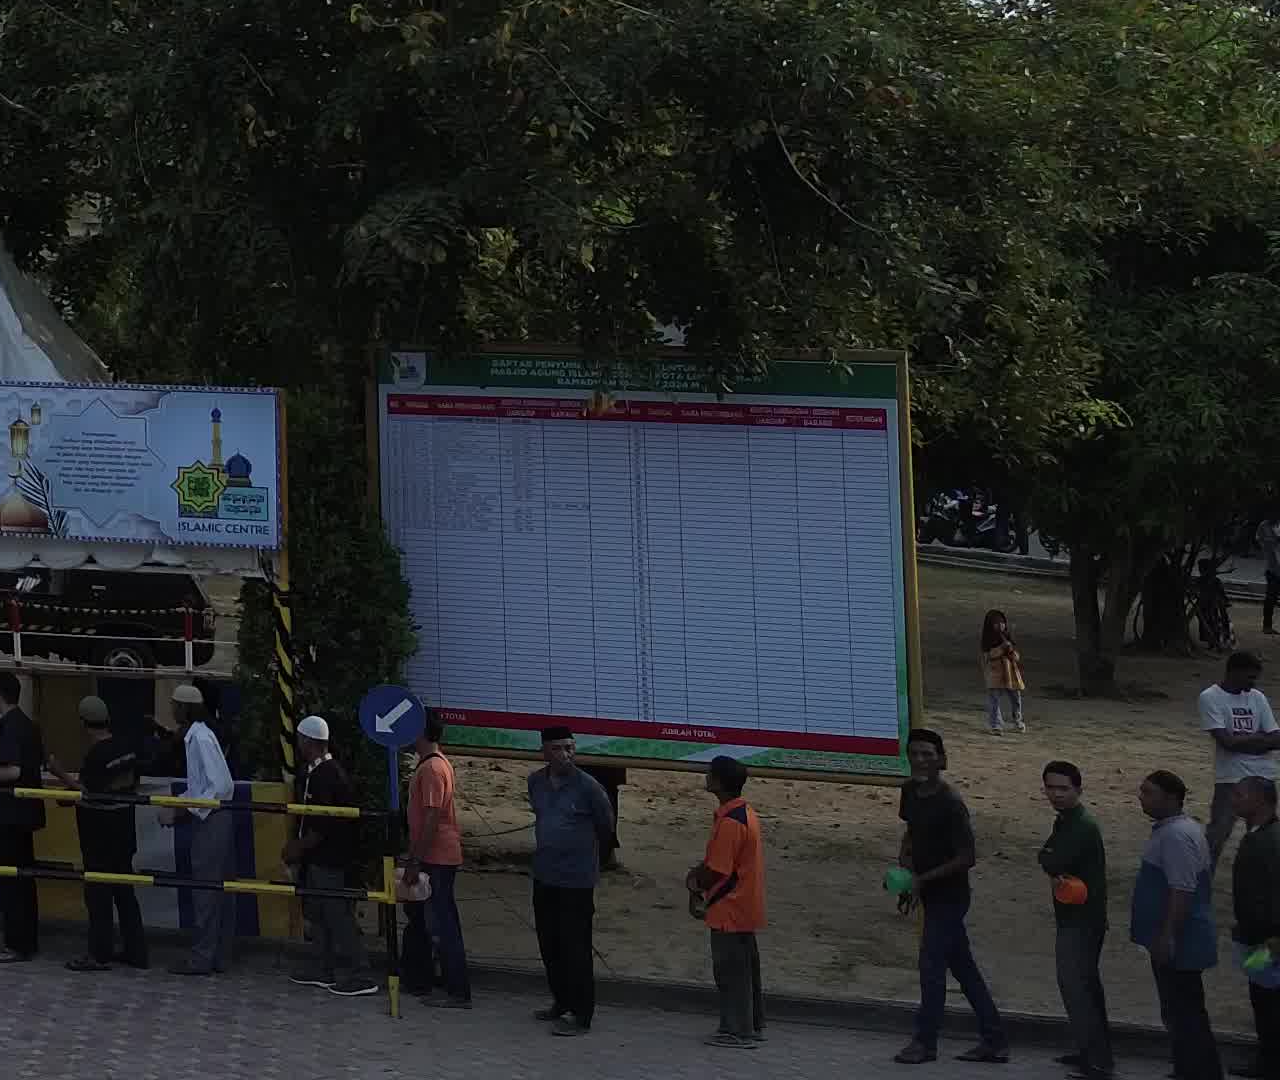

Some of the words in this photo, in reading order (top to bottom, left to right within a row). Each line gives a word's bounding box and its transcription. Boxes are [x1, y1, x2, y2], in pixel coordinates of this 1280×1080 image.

[178, 521, 223, 534] ISLAMIC
[225, 523, 270, 536] CENTRE
[693, 729, 717, 739] TOTAL
